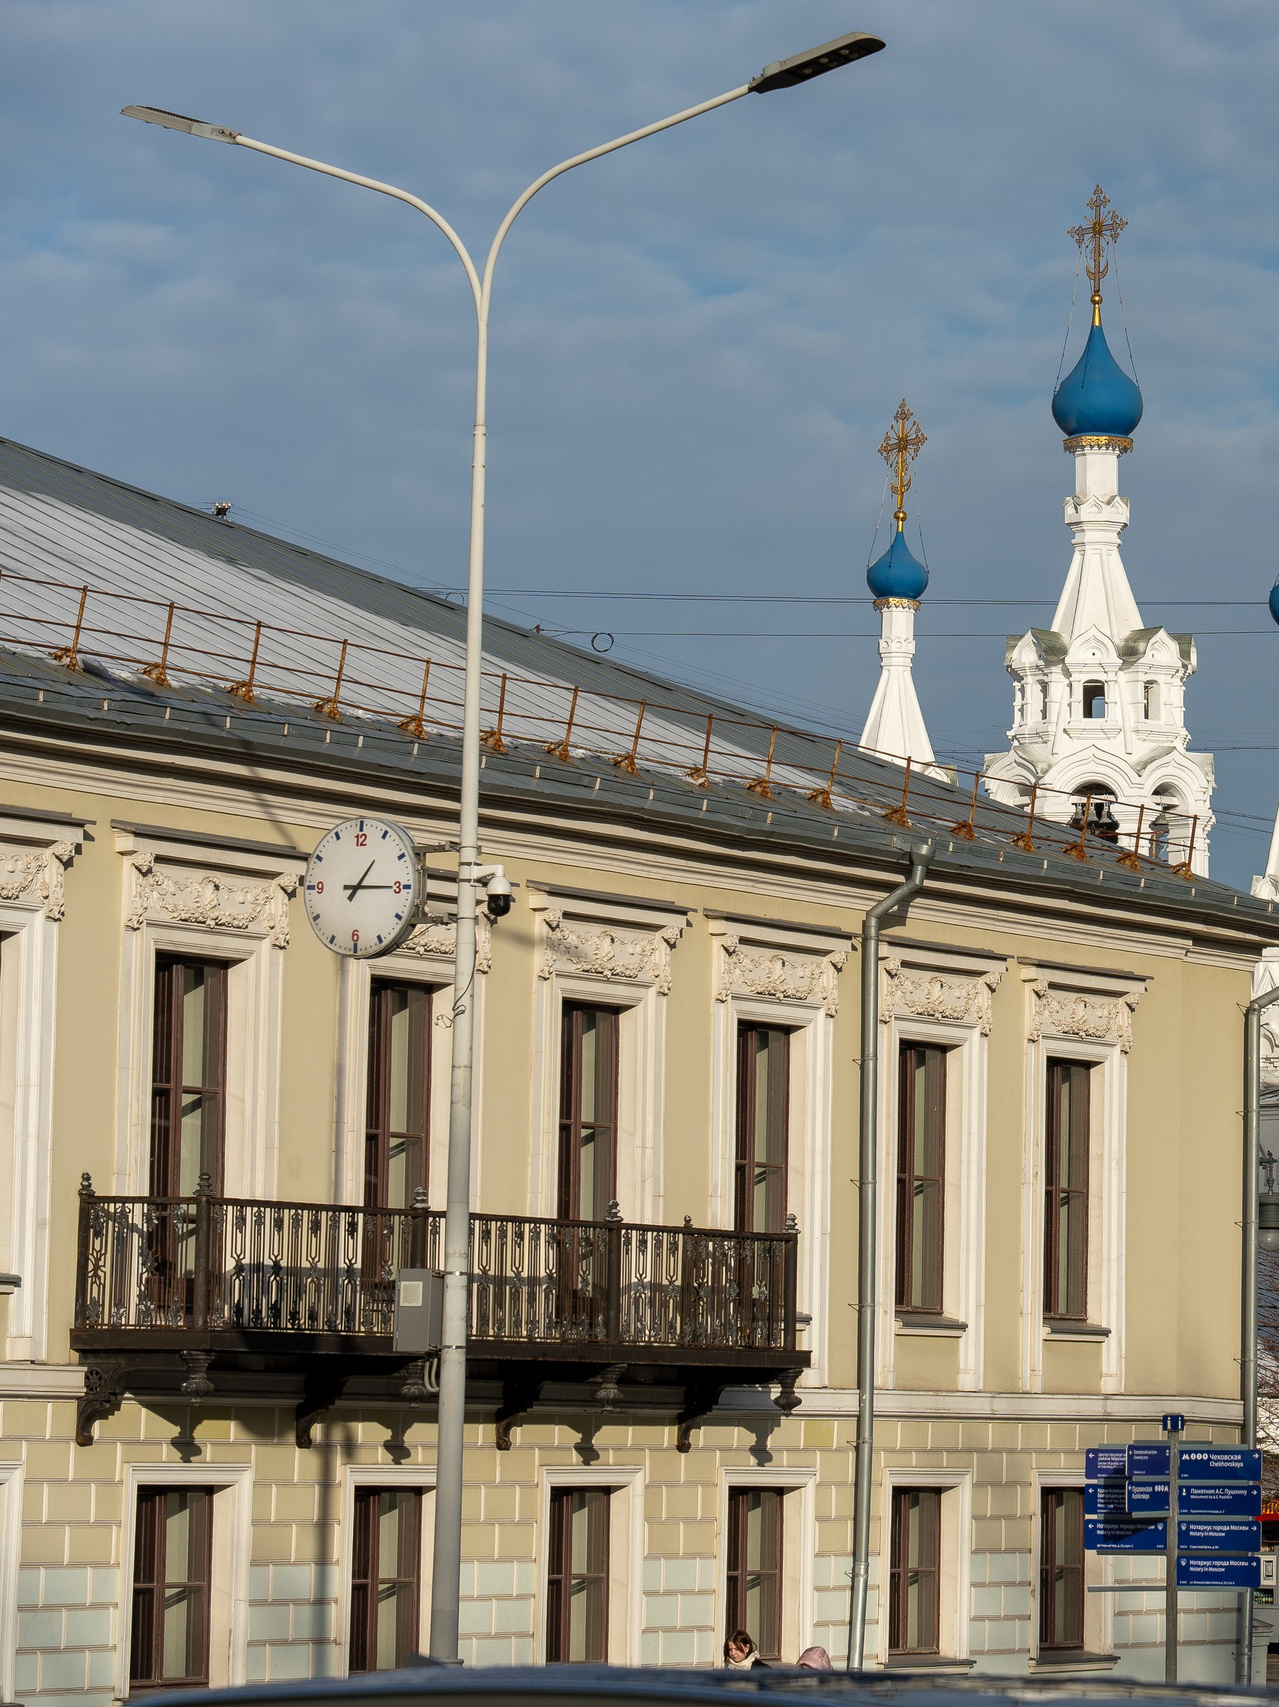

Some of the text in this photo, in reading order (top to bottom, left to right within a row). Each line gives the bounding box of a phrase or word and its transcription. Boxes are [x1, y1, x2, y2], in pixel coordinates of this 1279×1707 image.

[354, 833, 367, 847] 12
[316, 881, 324, 894] 9
[393, 881, 401, 894] 3
[351, 929, 359, 943] 6
